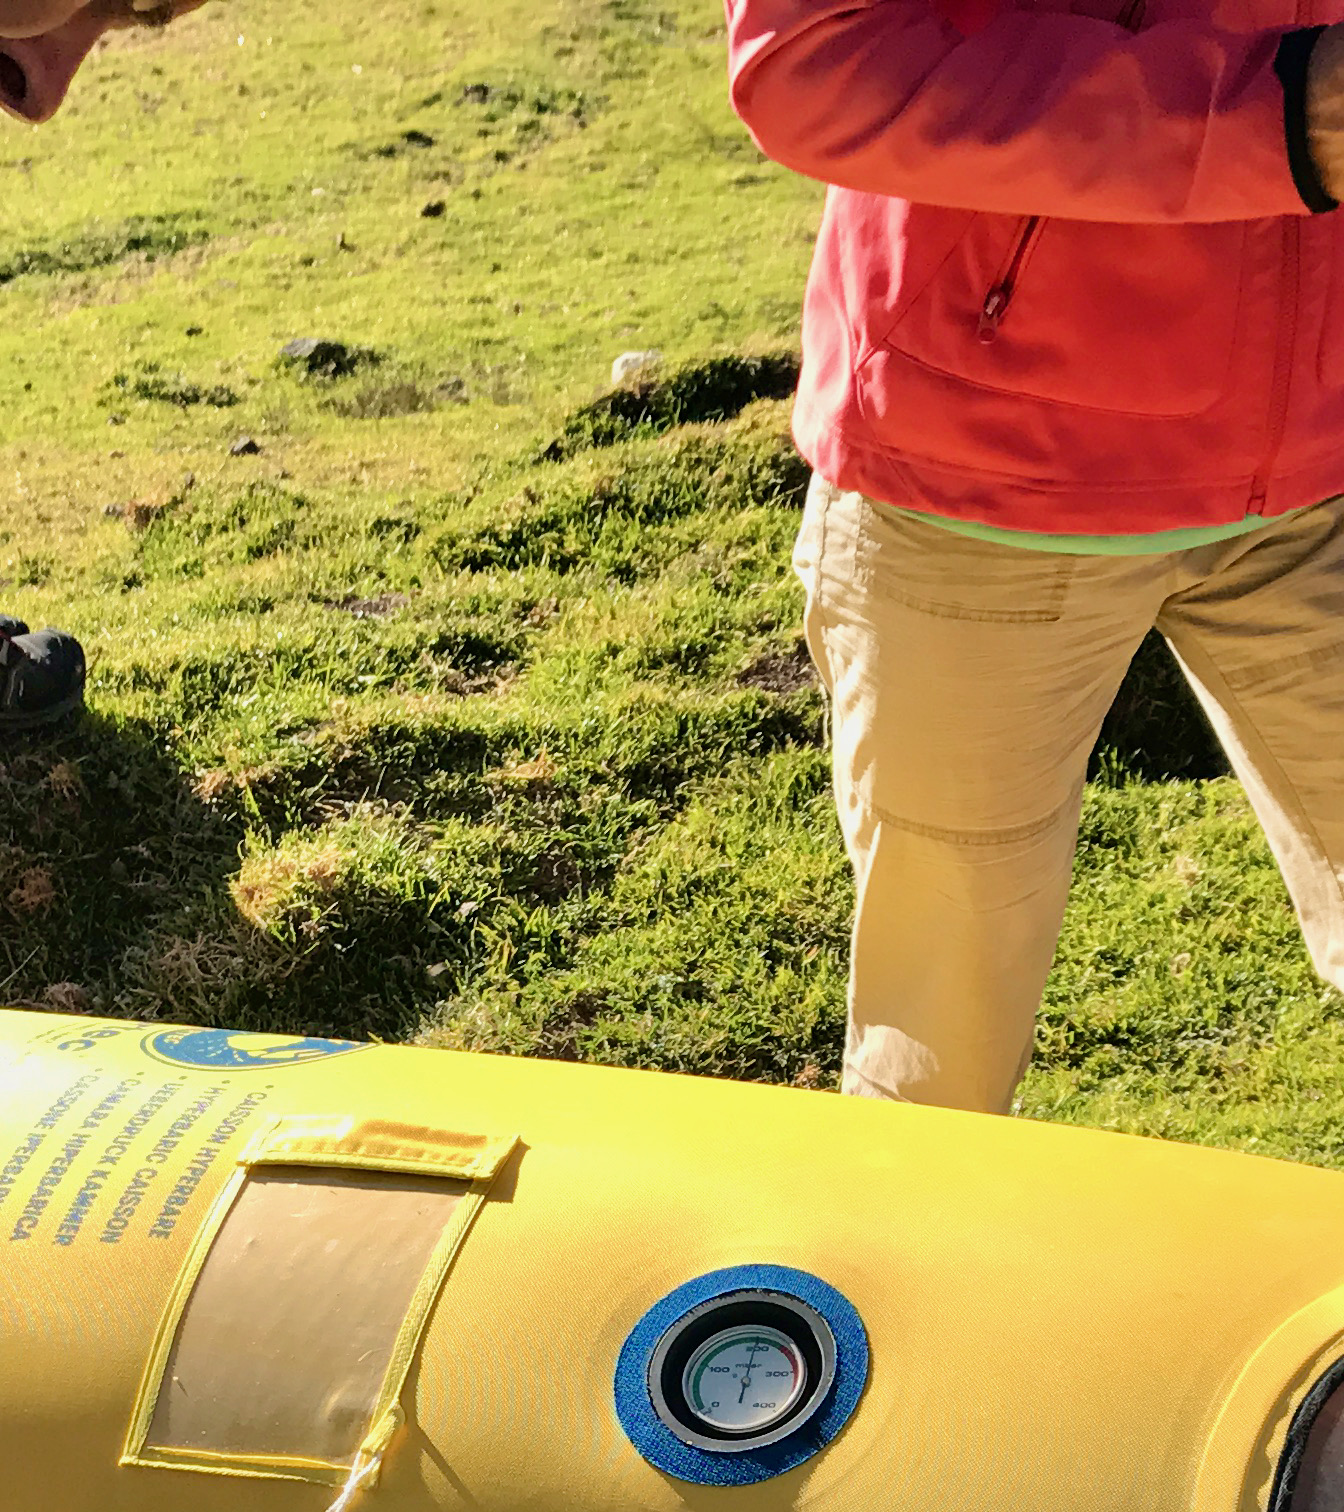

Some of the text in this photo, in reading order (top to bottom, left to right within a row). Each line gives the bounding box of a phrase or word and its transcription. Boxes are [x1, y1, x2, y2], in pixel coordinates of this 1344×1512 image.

[9, 1078, 141, 1242] CAMARA HIPERBARICA
[34, 1074, 99, 1129] CASSONE
[53, 1083, 184, 1246] UEBERDRUCK KAMMER
[100, 1087, 227, 1243] HYPERBARIC CAISSON
[149, 1092, 267, 1239] CAISSON HYPERBARE
